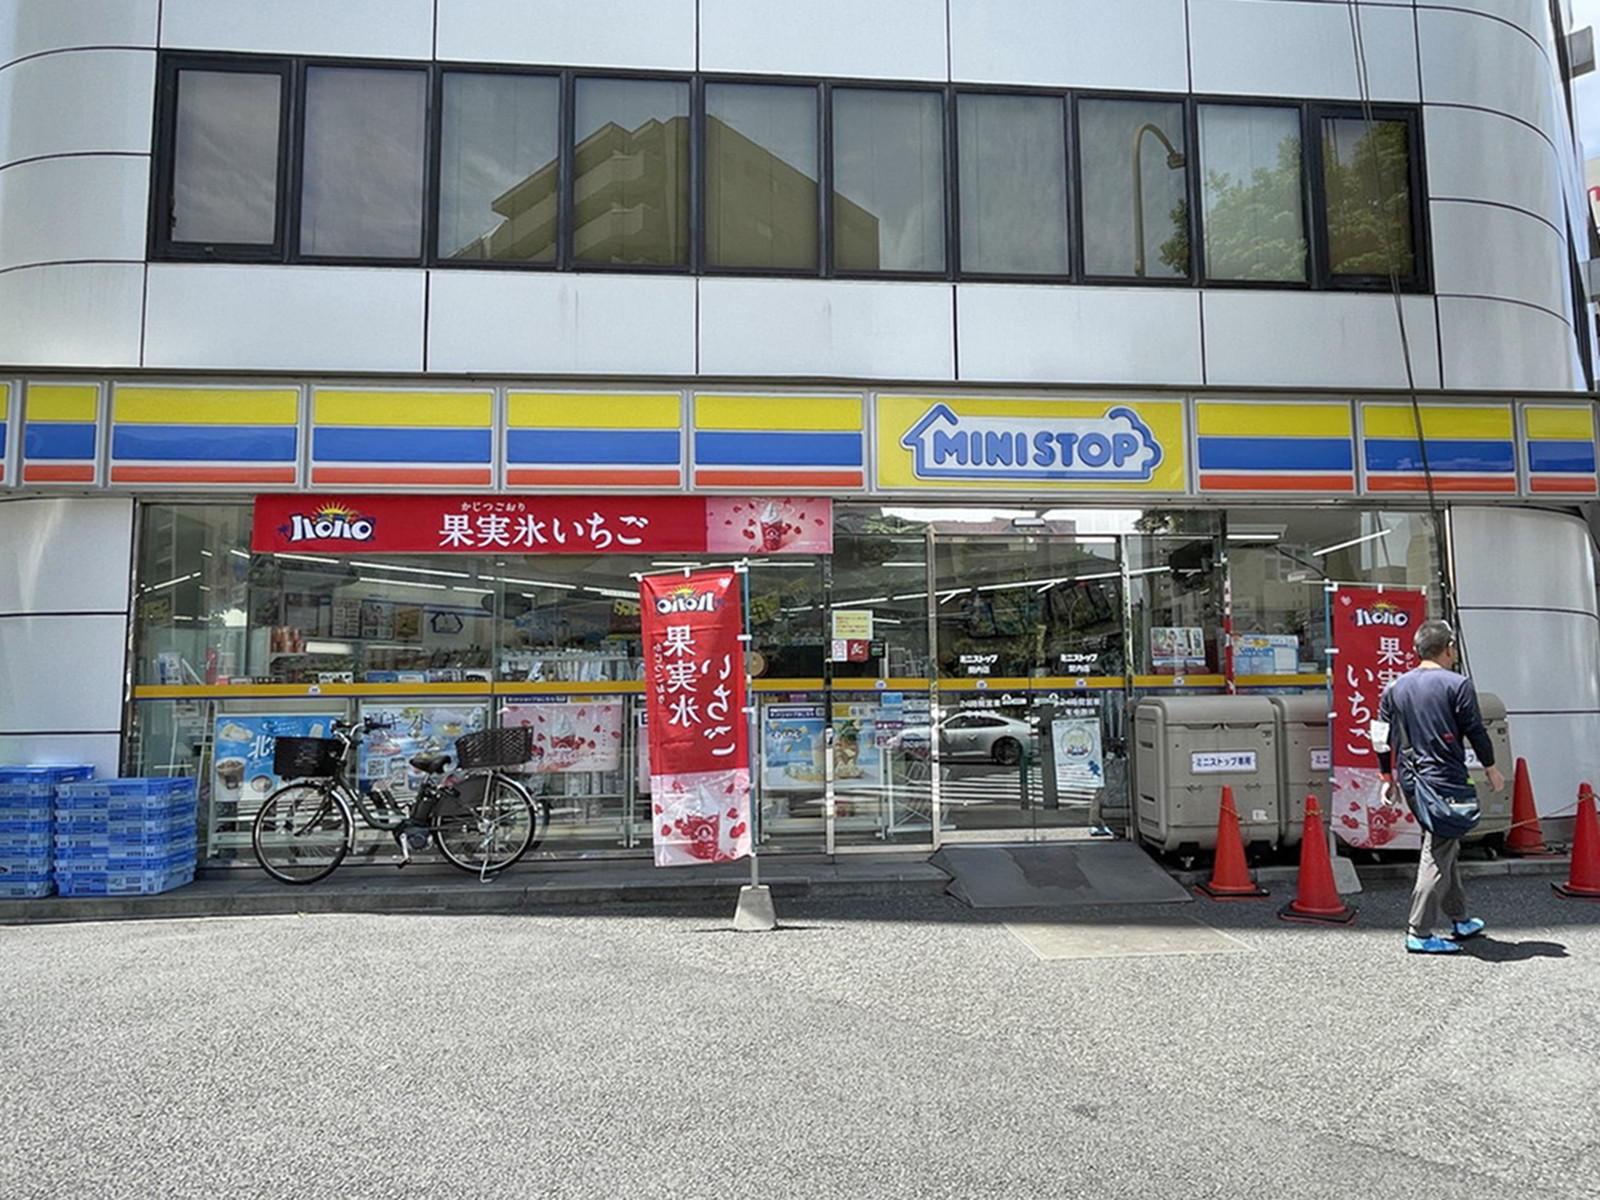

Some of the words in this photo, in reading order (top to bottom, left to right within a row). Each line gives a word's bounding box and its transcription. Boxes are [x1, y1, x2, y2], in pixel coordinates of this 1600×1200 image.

[461, 502, 526, 513] かじつごおり
[439, 512, 649, 549] 果実氷いちご
[1346, 664, 1374, 755] いちご
